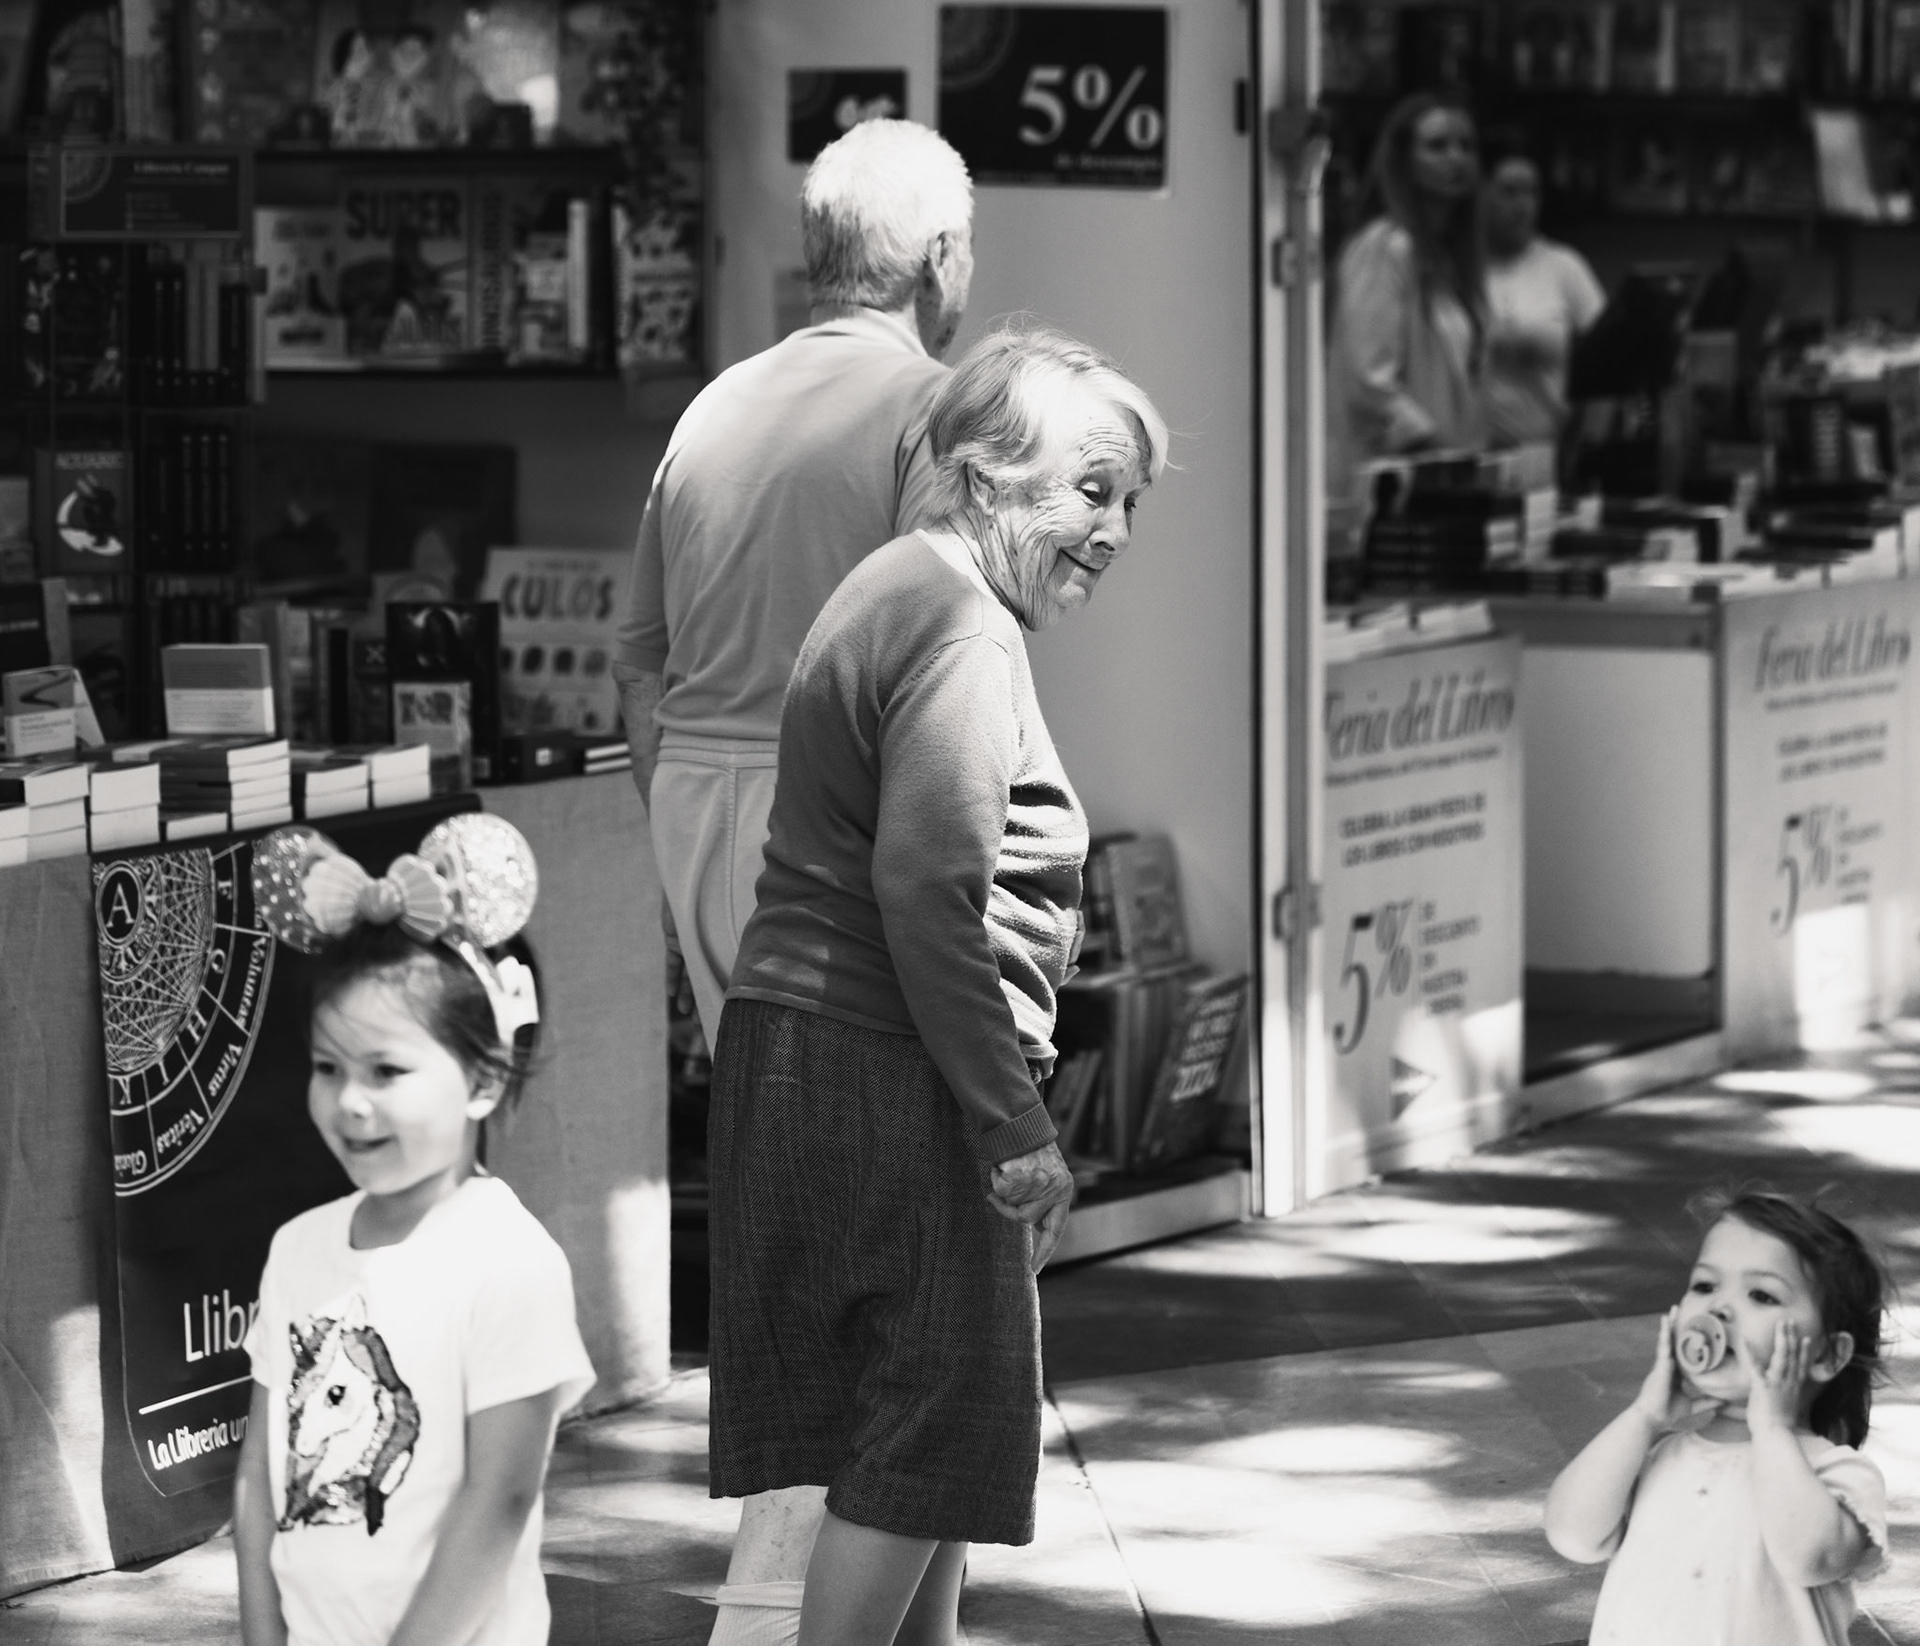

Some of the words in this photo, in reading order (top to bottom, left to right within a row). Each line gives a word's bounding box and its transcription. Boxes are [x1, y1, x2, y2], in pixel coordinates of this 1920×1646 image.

[1019, 65, 1162, 152] 5%
[500, 573, 615, 622] CULOS
[1753, 624, 1816, 692] Feria
[1817, 618, 1853, 682] del
[1851, 610, 1911, 677] Libro
[1391, 674, 1444, 752] del
[1439, 665, 1515, 742] Libro
[1769, 803, 1833, 938] 5%
[106, 882, 134, 928] A
[235, 936, 267, 1029] Voluntas
[1333, 898, 1413, 1056] 5%
[186, 1010, 208, 1043] H
[208, 1043, 243, 1097] Virtus
[156, 1108, 204, 1154] Veritas
[147, 1439, 173, 1471] La
[167, 1417, 229, 1464] Llibreria
